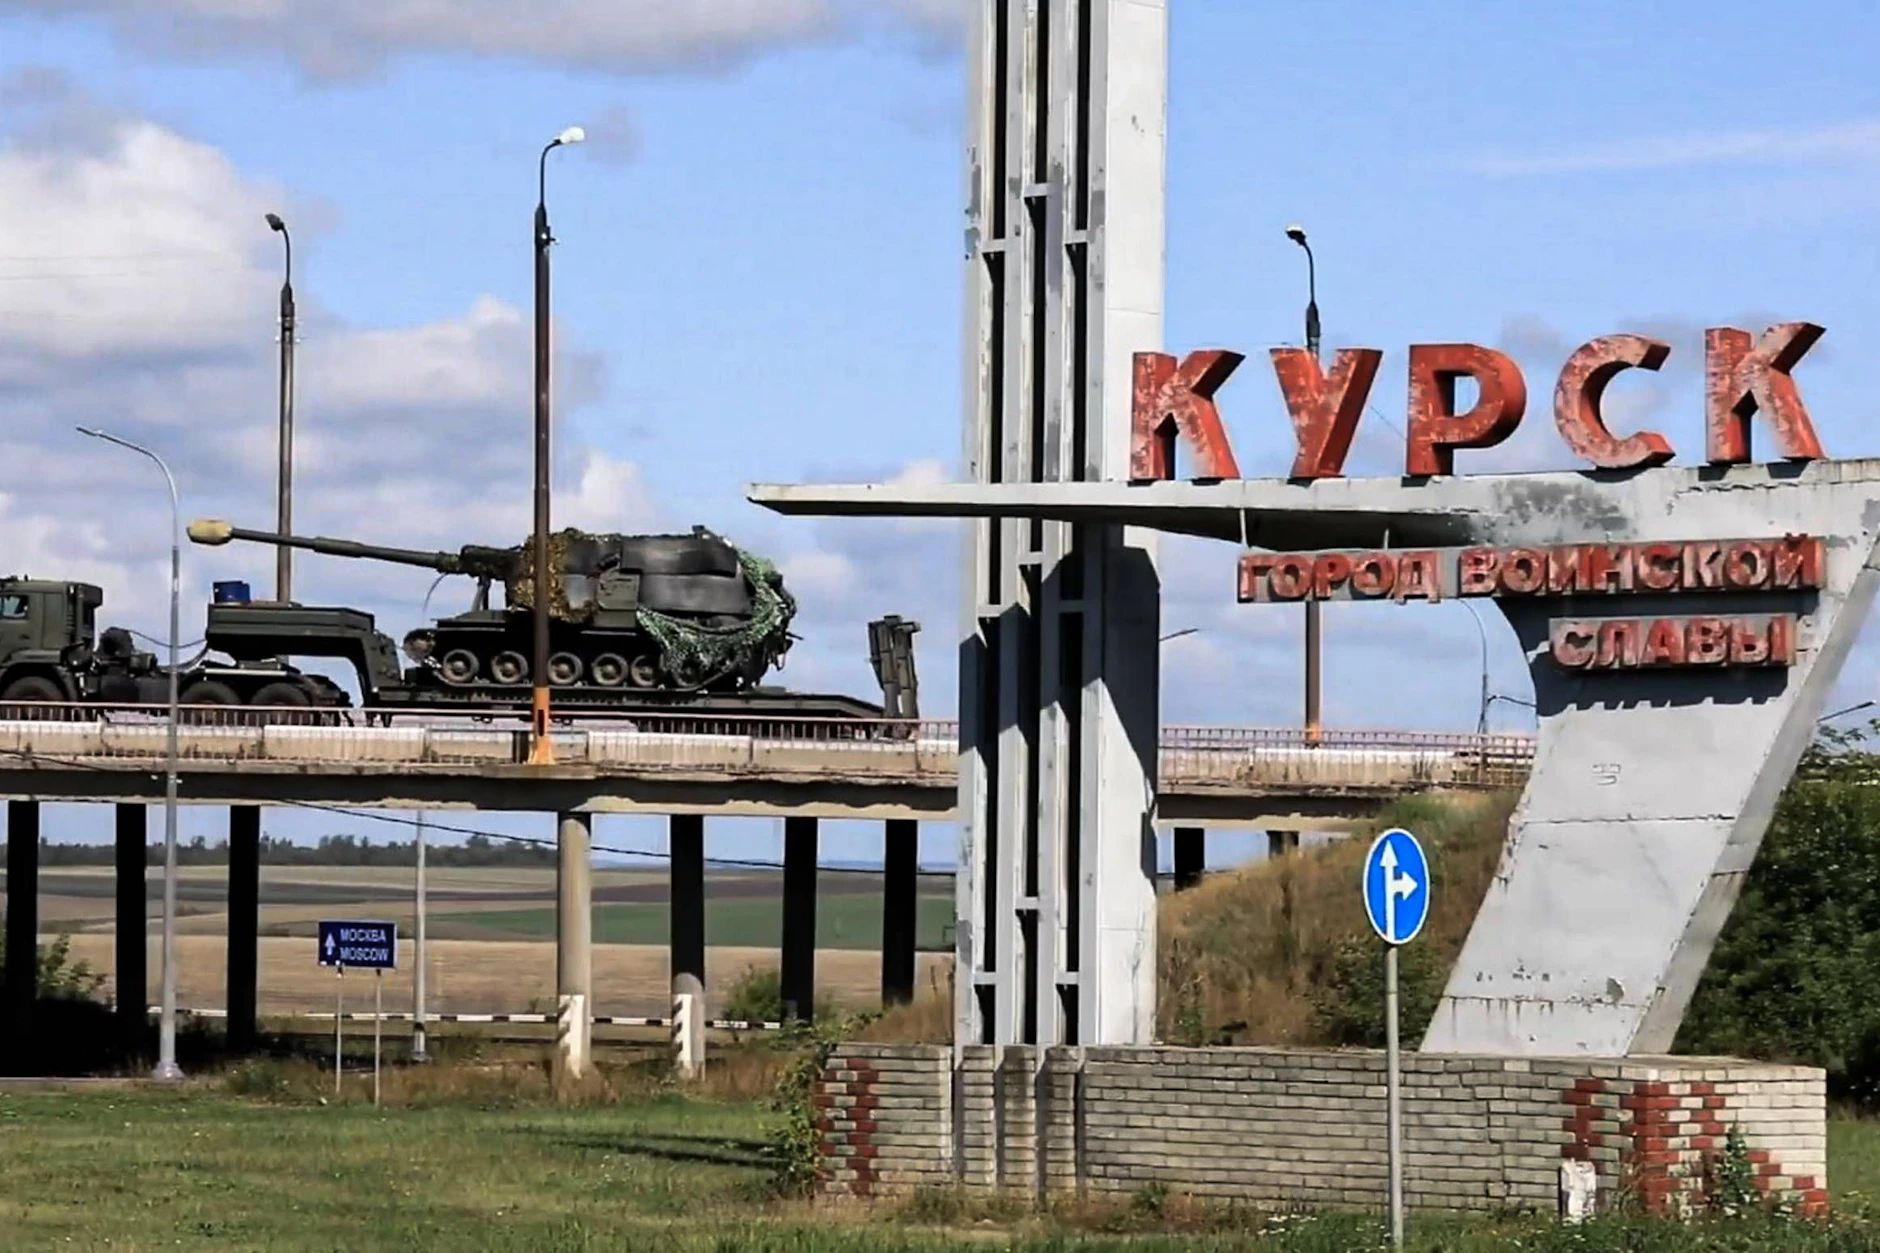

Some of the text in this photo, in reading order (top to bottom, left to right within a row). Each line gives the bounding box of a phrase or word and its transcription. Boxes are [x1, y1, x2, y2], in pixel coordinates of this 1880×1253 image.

[1131, 322, 1827, 480] КУРСК
[1238, 533, 1823, 604] ГОРОД ВОИНСКОЙ
[1551, 614, 1792, 669] СЛАВЫ
[340, 928, 387, 943] МОСКВА
[340, 946, 389, 961] MOSCOW
